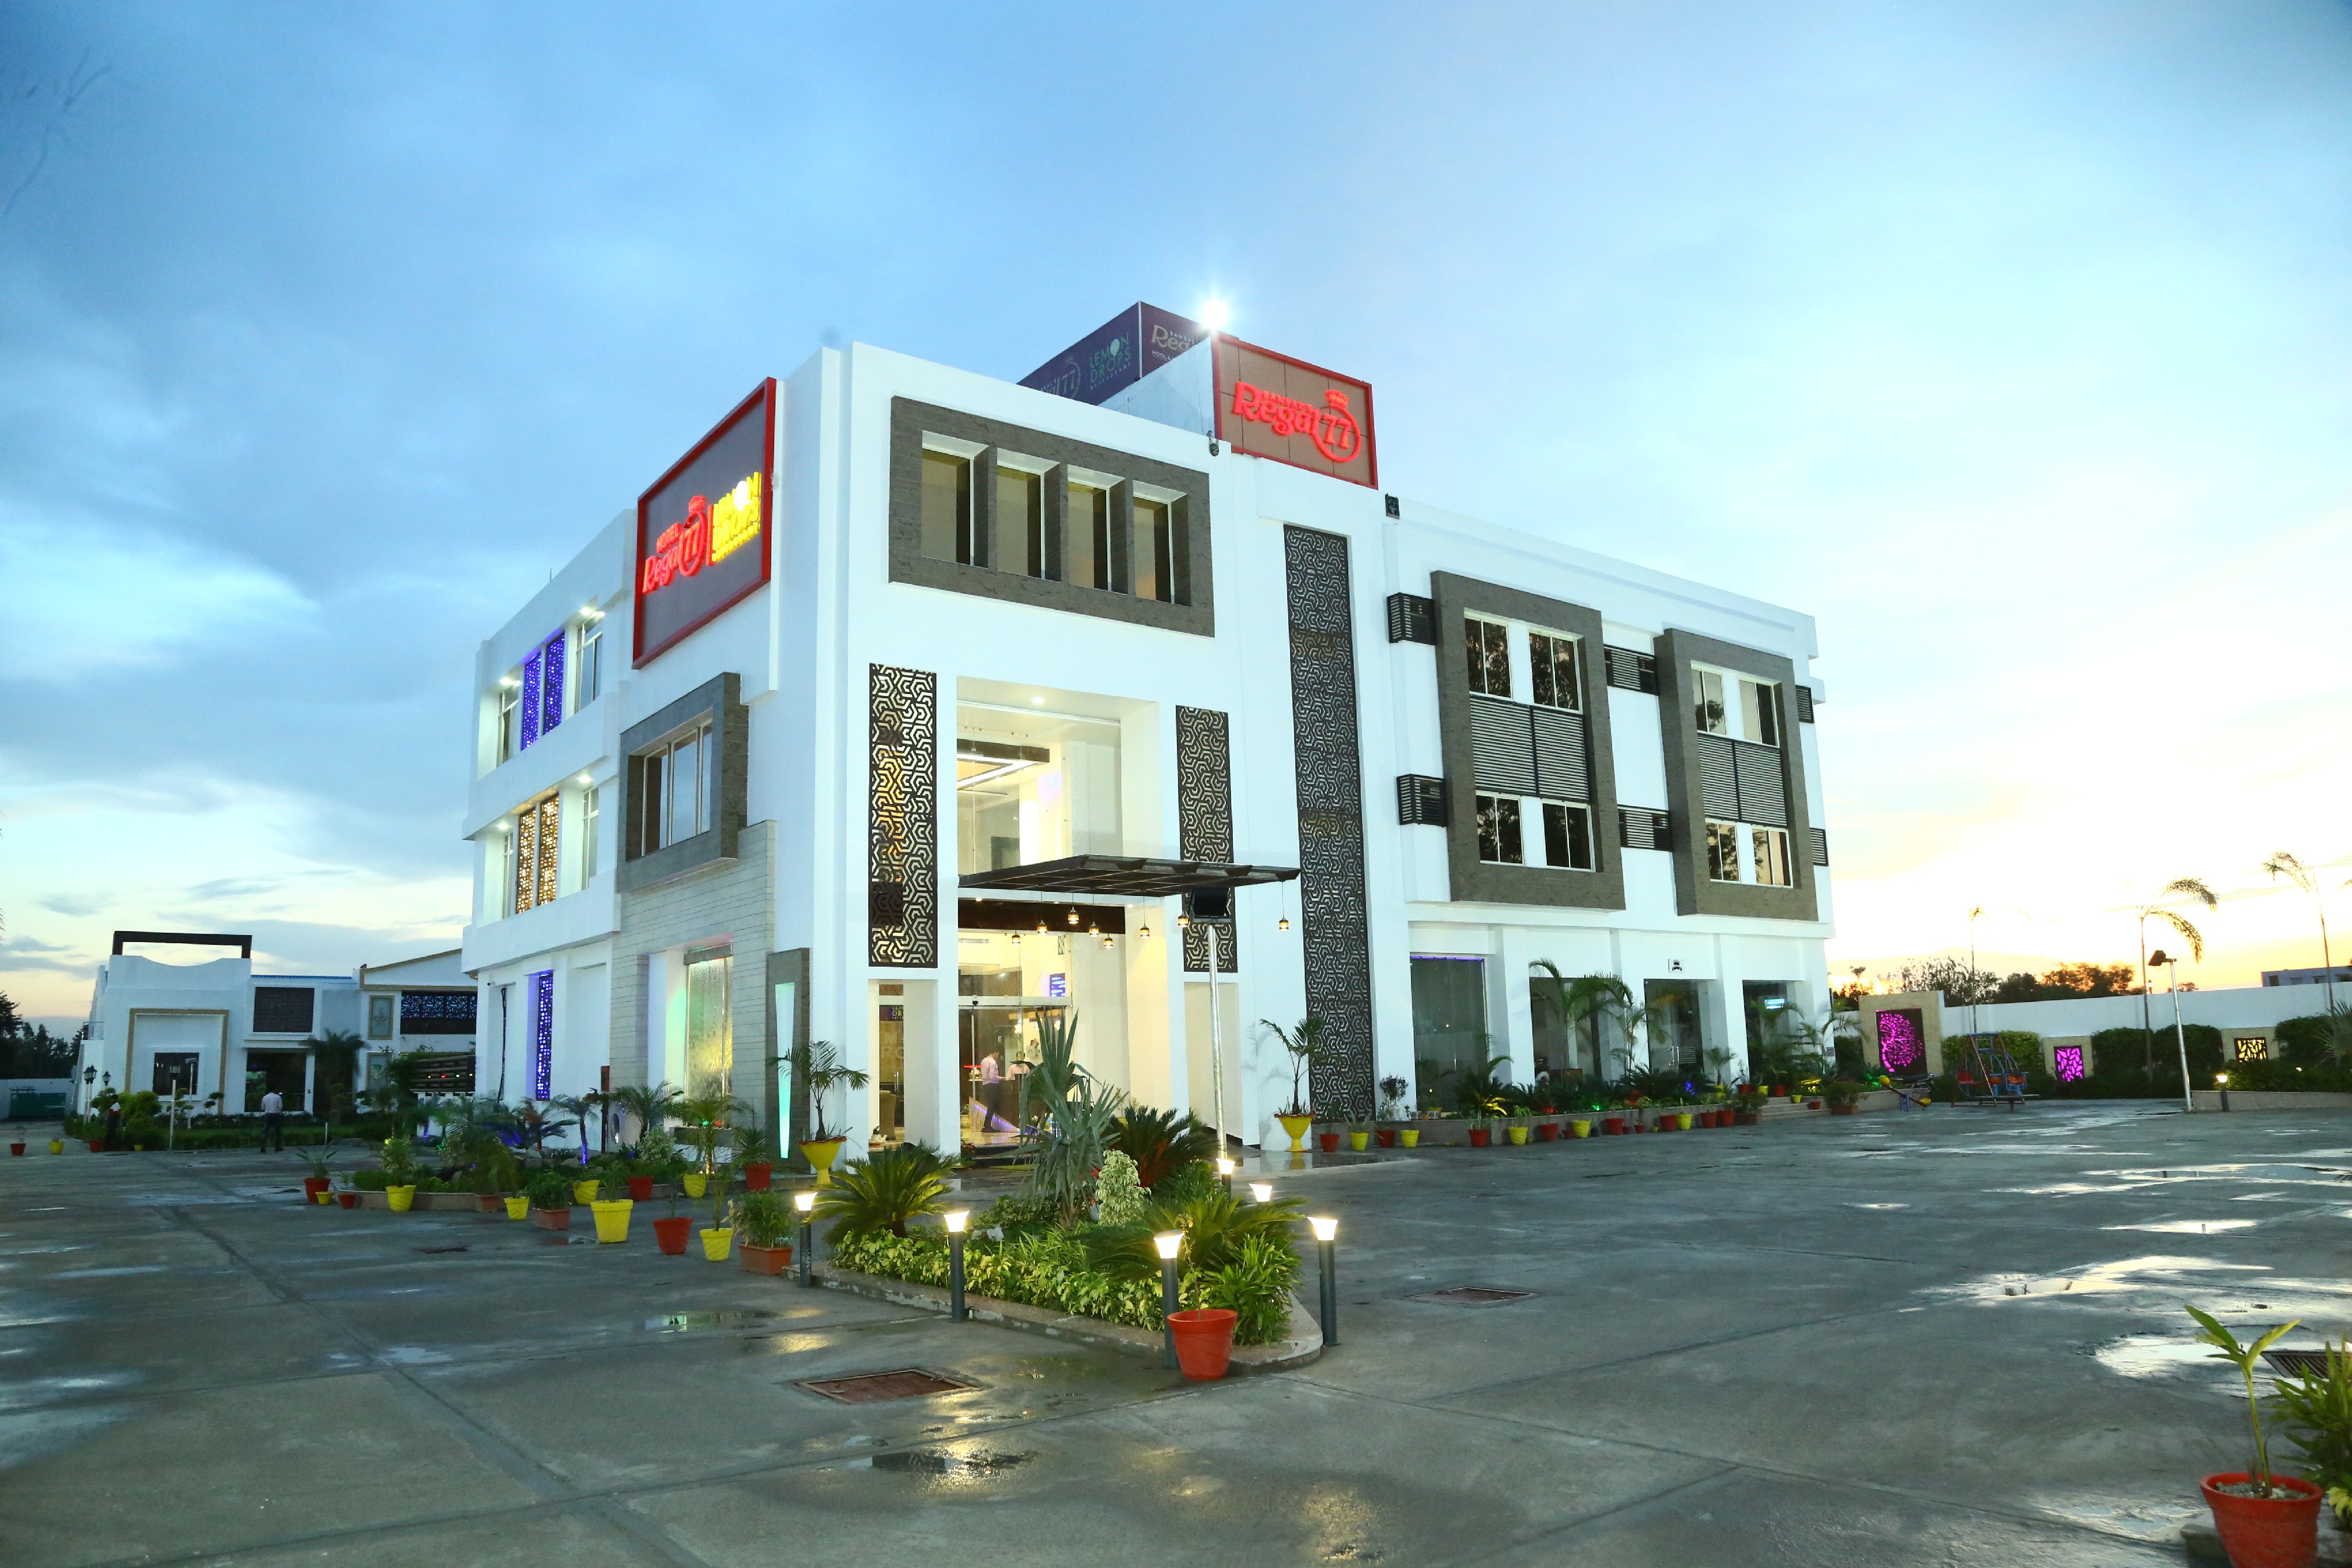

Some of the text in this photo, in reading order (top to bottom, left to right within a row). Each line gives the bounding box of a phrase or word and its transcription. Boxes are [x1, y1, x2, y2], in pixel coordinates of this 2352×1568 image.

[1090, 332, 1130, 369] LEMON
[1091, 346, 1130, 383] DROPS
[1152, 350, 1166, 359] HOTEL
[1233, 381, 1352, 449] Regal 77
[712, 496, 761, 551] DROPS
[642, 531, 685, 593] Regal
